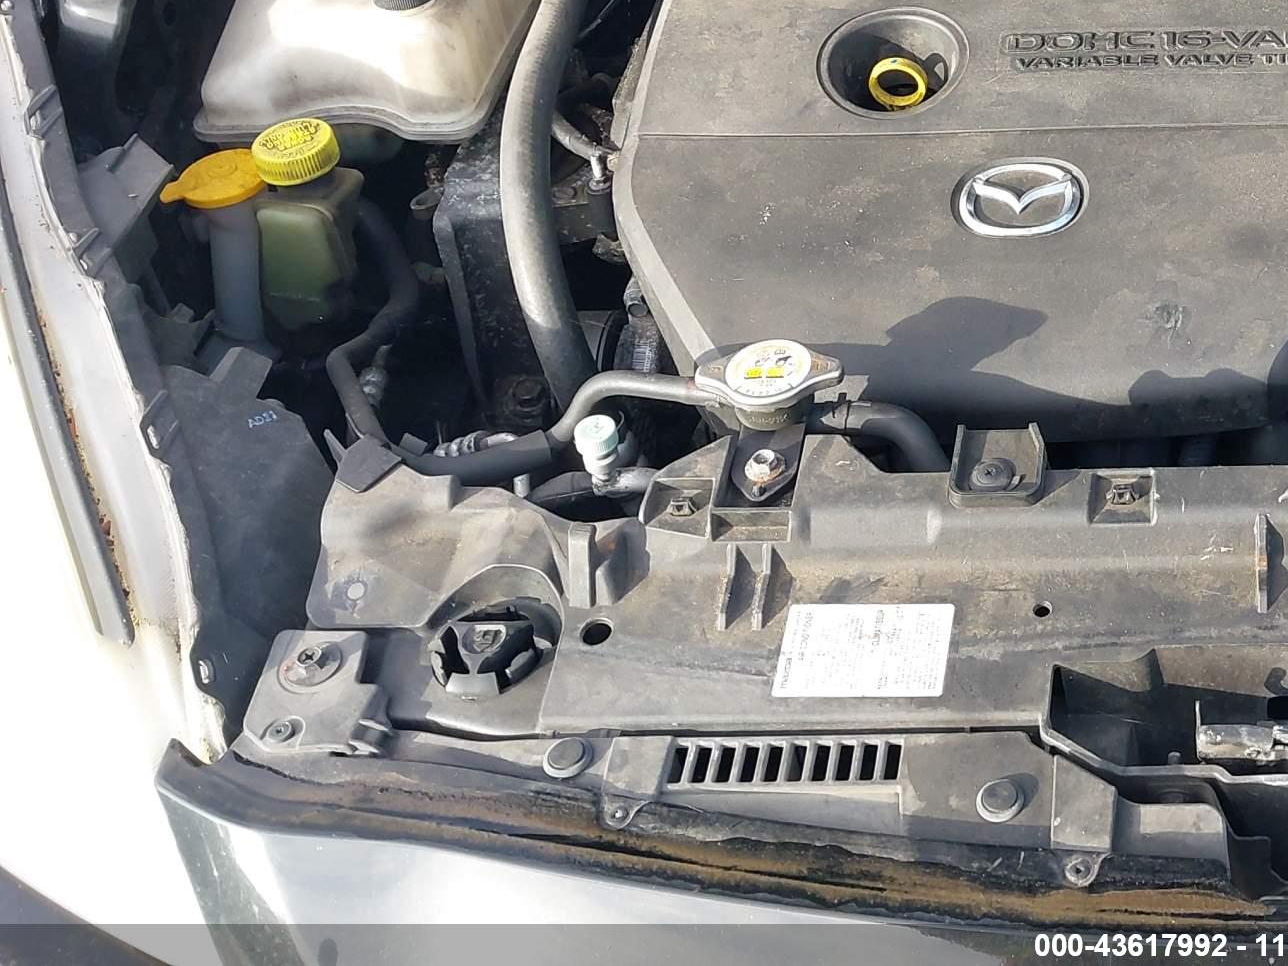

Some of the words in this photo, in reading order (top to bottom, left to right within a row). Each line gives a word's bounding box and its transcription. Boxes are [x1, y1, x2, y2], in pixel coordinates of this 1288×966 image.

[1006, 31, 1155, 52] DOHC
[1015, 53, 1159, 68] VARIABLE
[1166, 52, 1254, 66] VALVE
